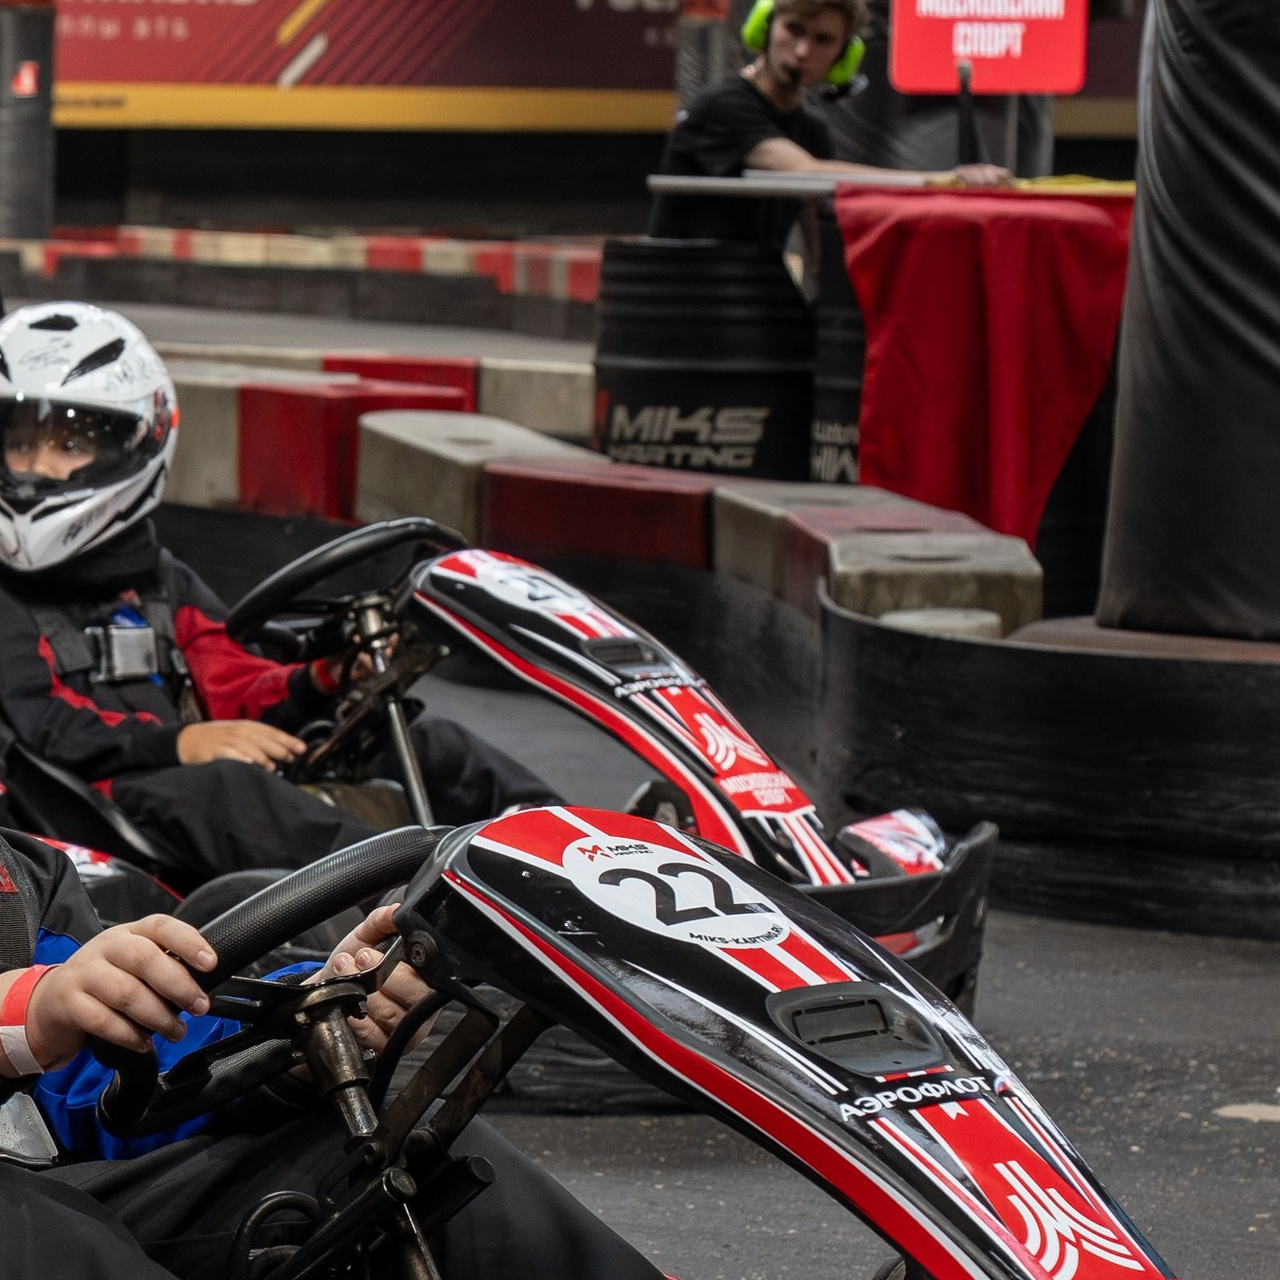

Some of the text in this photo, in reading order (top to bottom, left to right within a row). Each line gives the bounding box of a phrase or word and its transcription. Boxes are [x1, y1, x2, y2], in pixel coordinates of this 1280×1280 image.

[952, 21, 1026, 59] СПОРТ
[610, 404, 771, 444] MIKS
[607, 843, 648, 852] MIKS
[599, 862, 777, 926] 22
[689, 923, 784, 945] MIKS-KARTING.RU
[838, 1077, 992, 1122] АЭРОФЛОТ
